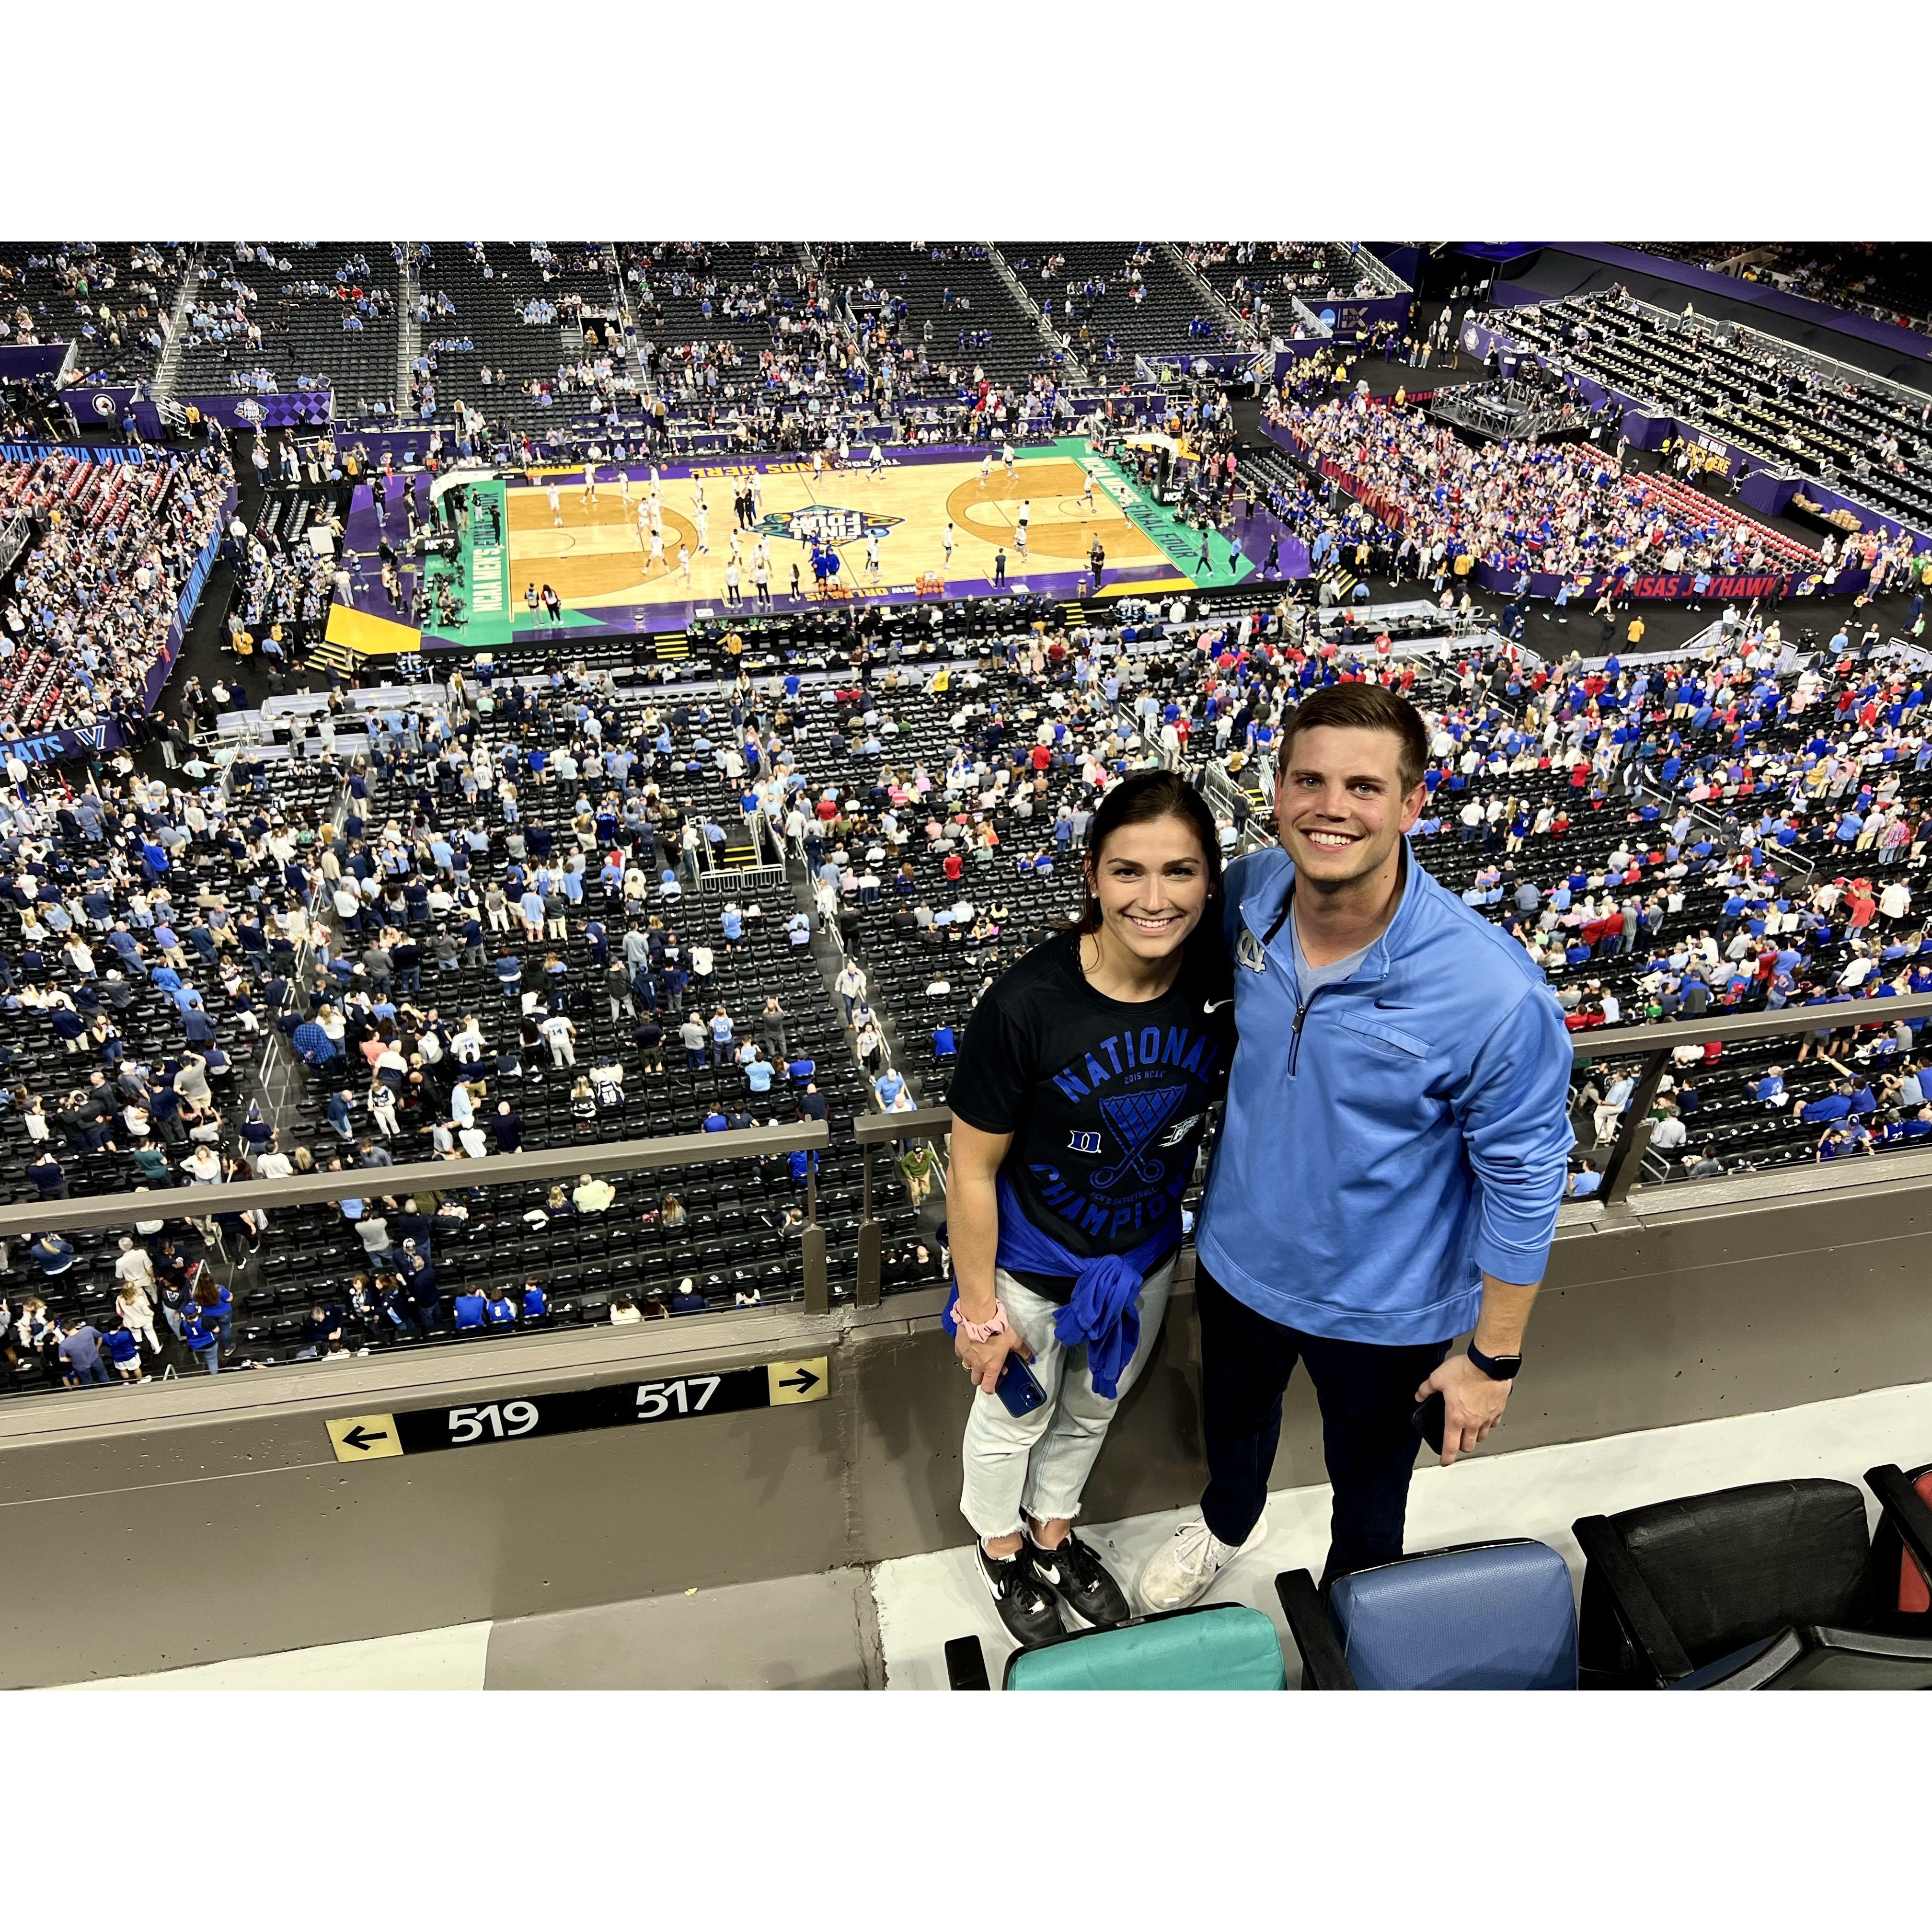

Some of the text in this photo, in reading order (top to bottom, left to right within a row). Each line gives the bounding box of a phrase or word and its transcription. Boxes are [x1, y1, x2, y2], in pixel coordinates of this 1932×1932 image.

[0, 445, 92, 463] VILLAVA
[1697, 435, 1727, 457] THE ROAD
[689, 465, 757, 478] HERE
[1707, 453, 1731, 474] ERE
[1163, 492, 1183, 502] NCA
[1122, 504, 1169, 532] FINAL
[789, 524, 862, 540] FINL
[425, 539, 455, 550] NCA
[1154, 533, 1198, 559] FOUR
[472, 548, 503, 612] NCAA MEN'S
[1682, 577, 1792, 597] JYHAWKS
[716, 1024, 728, 1033] 50
[1052, 1026, 1219, 1104] NATIONAL
[1124, 1073, 1142, 1084] 2015
[602, 1090, 617, 1103] 50
[1090, 1187, 1157, 1206] MEN'S BASKETBALL
[191, 1327, 198, 1335] 1
[448, 1376, 721, 1443] 519 517
